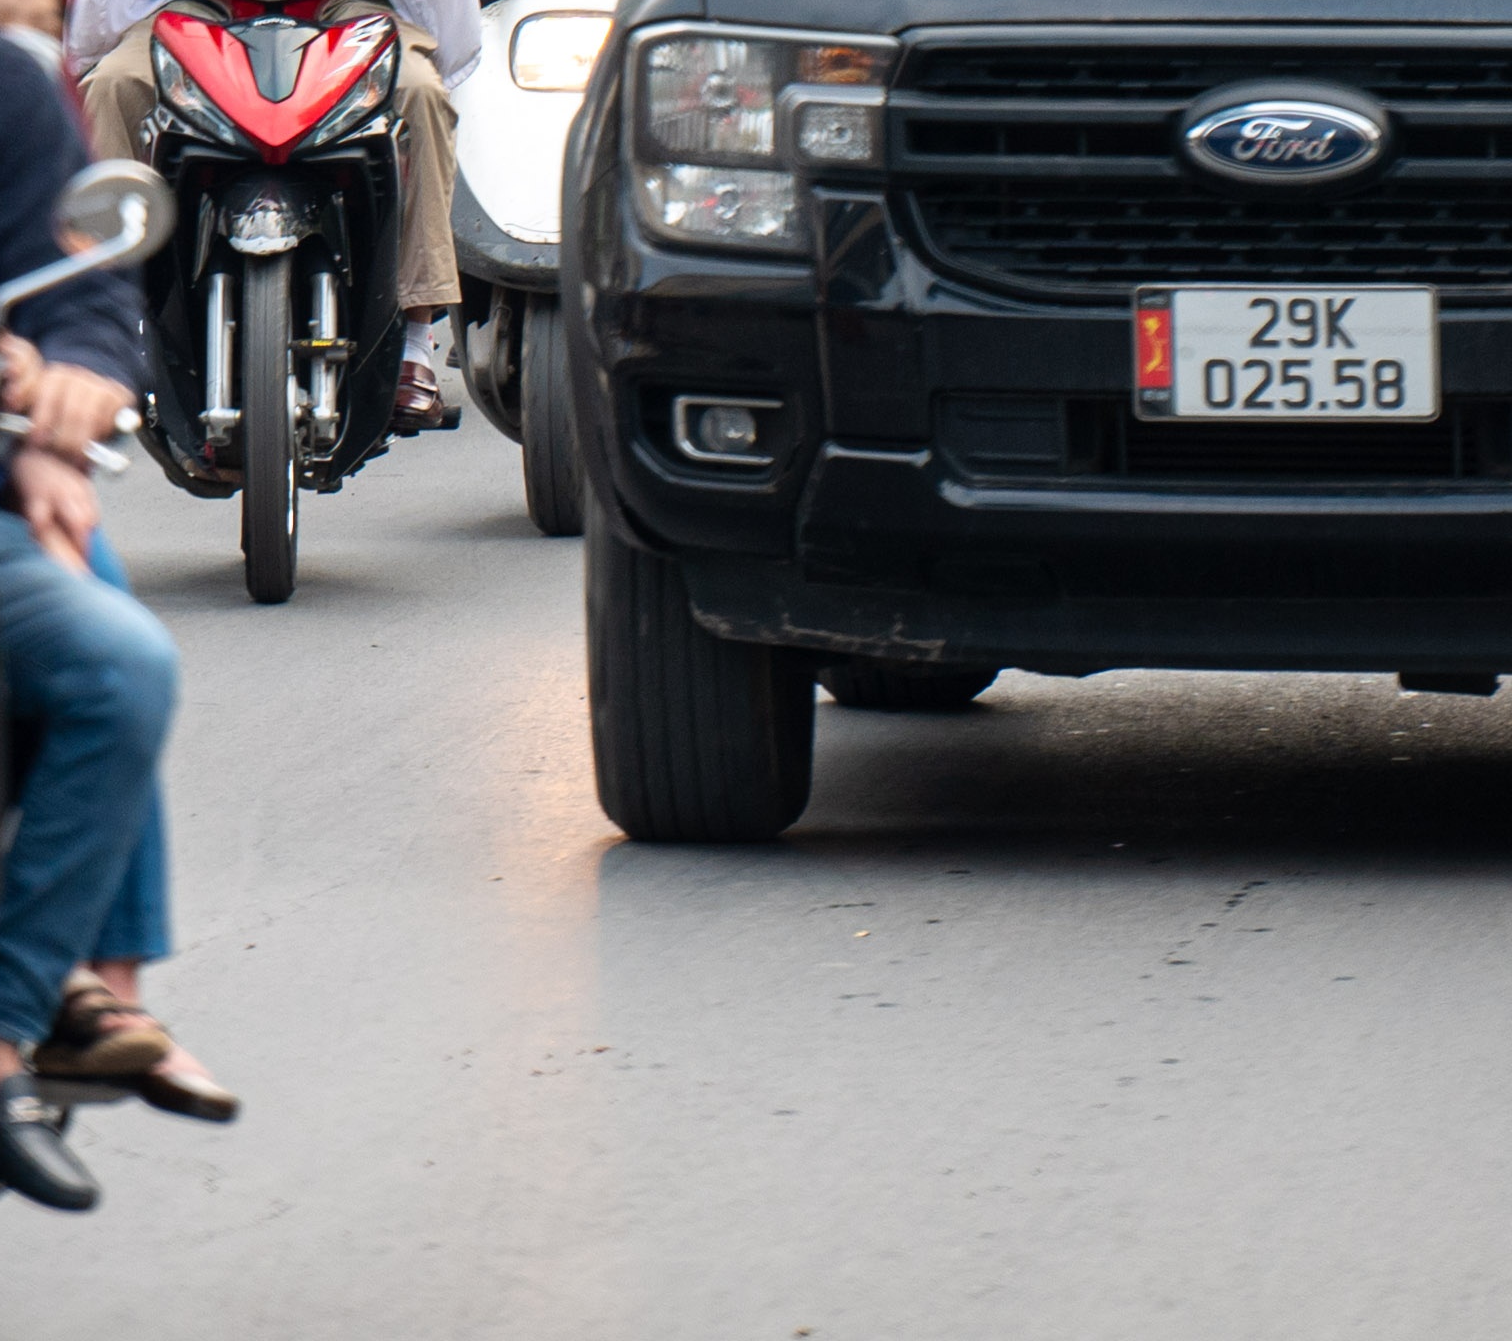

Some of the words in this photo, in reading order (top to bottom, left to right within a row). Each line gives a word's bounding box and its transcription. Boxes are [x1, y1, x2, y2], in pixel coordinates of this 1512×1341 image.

[1232, 117, 1336, 163] Ford
[1248, 297, 1357, 350] 29K
[1203, 358, 1406, 411] 025.58
